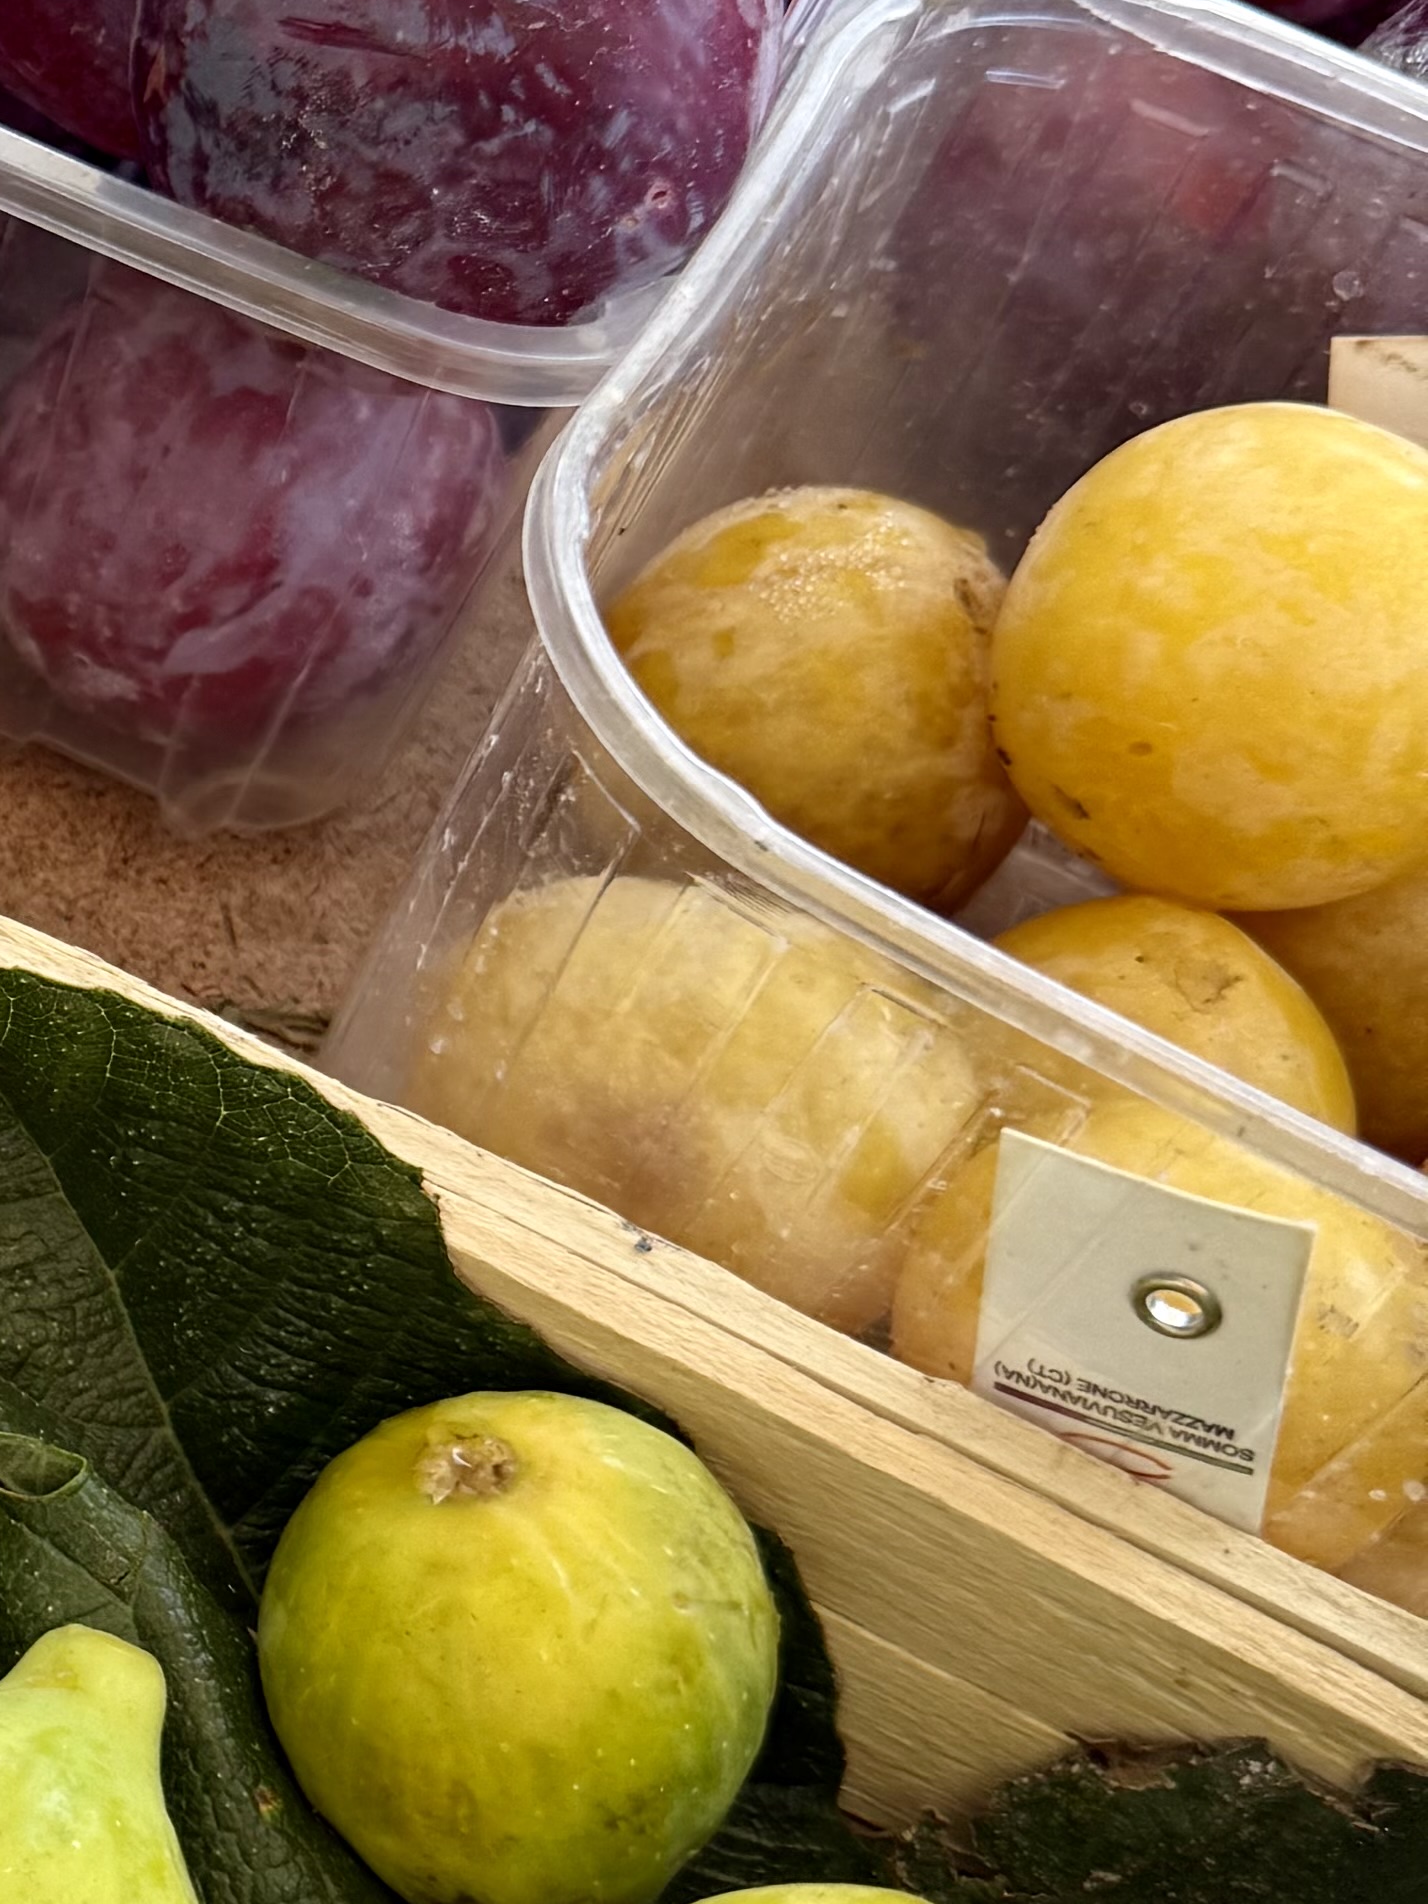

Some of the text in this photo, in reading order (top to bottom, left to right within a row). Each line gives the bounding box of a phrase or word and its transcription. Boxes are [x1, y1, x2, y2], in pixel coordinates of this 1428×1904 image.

[1025, 1358, 1235, 1440] MAZZARRONE (CT)
[1168, 1430, 1256, 1462] SOMMA
